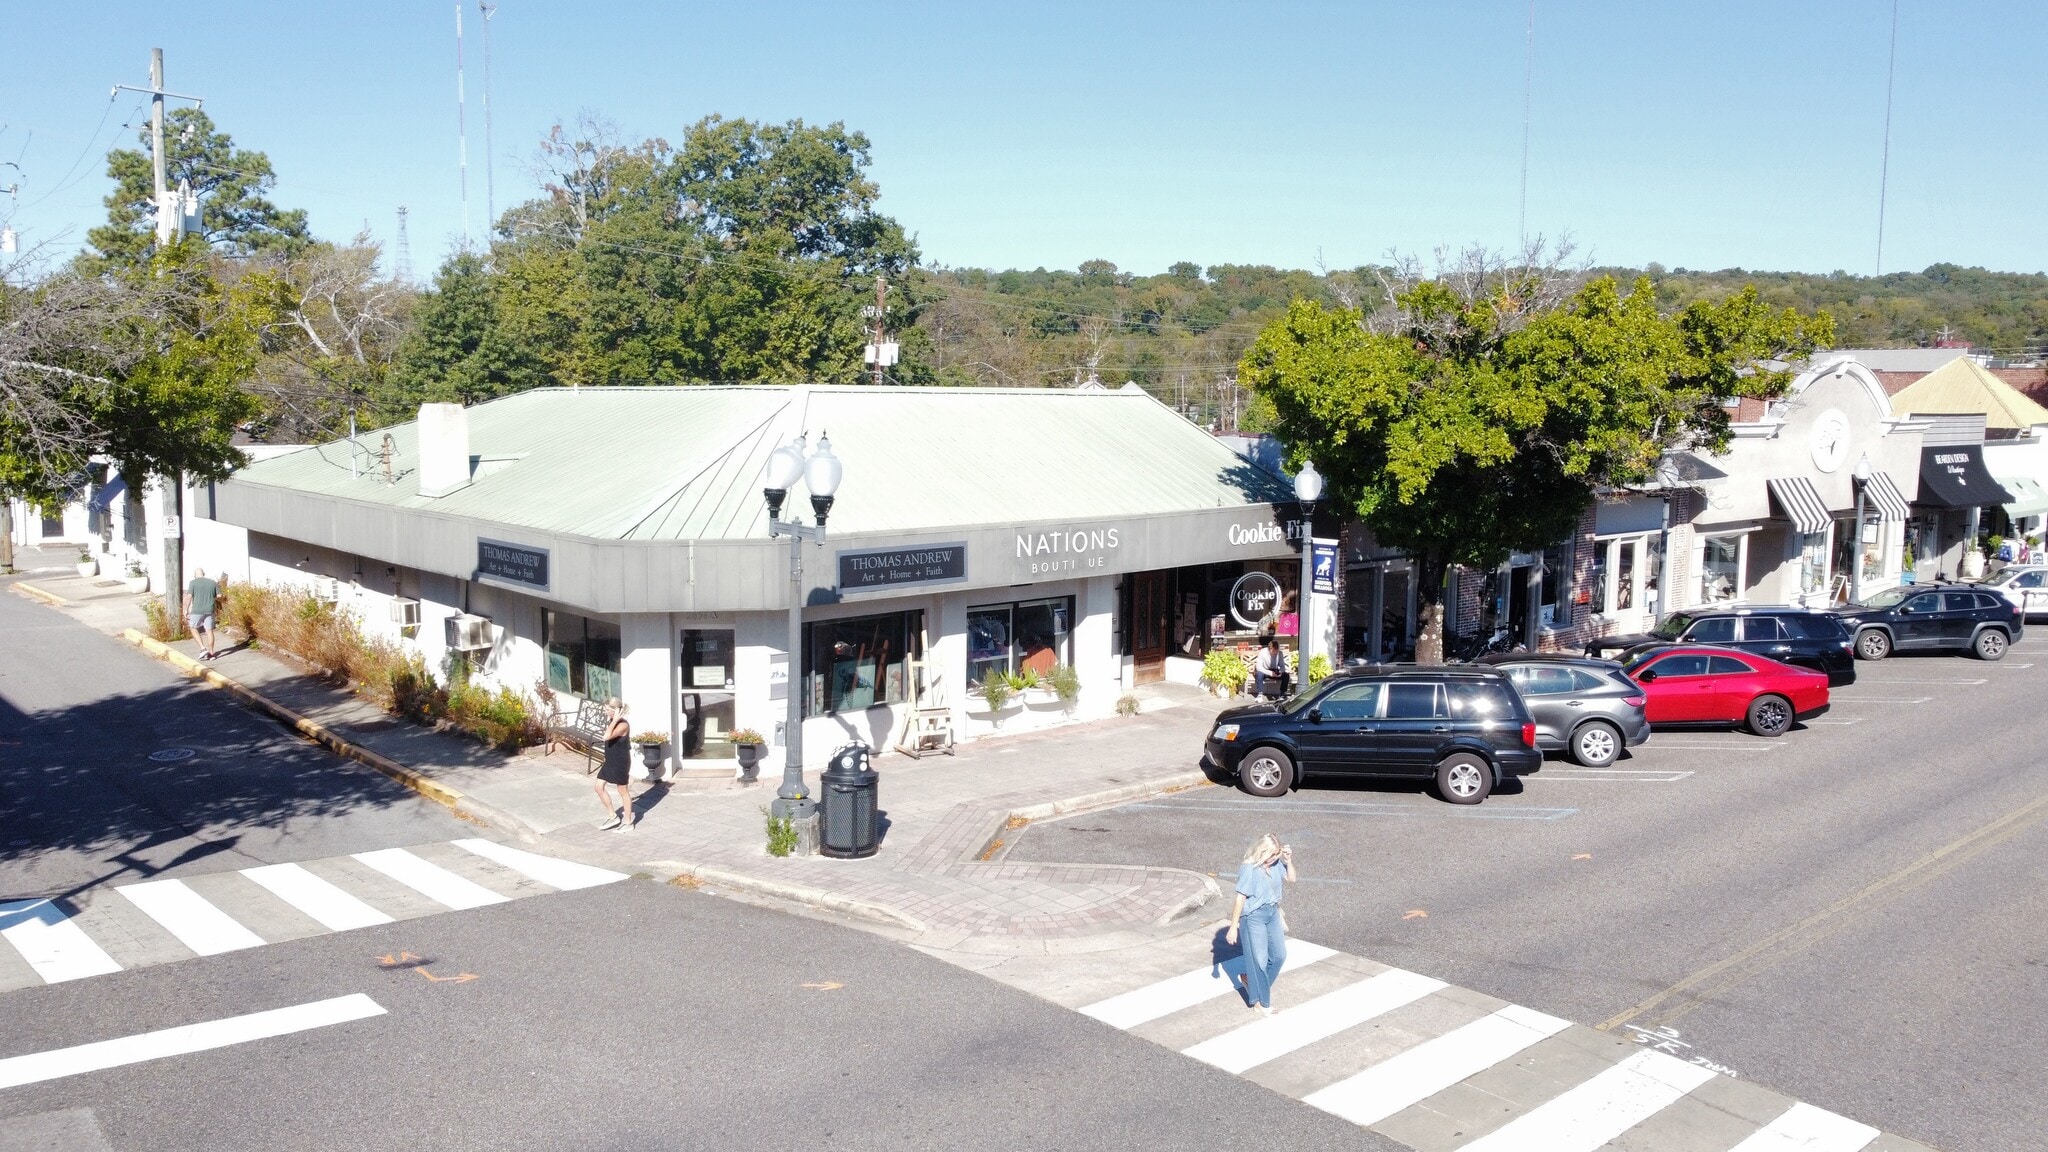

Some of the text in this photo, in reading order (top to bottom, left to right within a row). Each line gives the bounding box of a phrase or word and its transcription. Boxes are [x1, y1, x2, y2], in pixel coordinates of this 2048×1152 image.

[1229, 521, 1282, 545] Cookie
[1016, 528, 1119, 558] NATIONS
[483, 546, 541, 567] THOMAS ANDREW
[851, 555, 901, 570] THOMAS
[903, 550, 953, 566] ANDREW
[489, 561, 497, 571] Art
[503, 564, 516, 575] Home
[523, 568, 535, 579] Faith
[862, 572, 875, 582] Art
[889, 570, 911, 580] Home
[925, 566, 943, 576] Faith
[1237, 589, 1275, 600] Cookie
[1247, 600, 1264, 611] Fix
